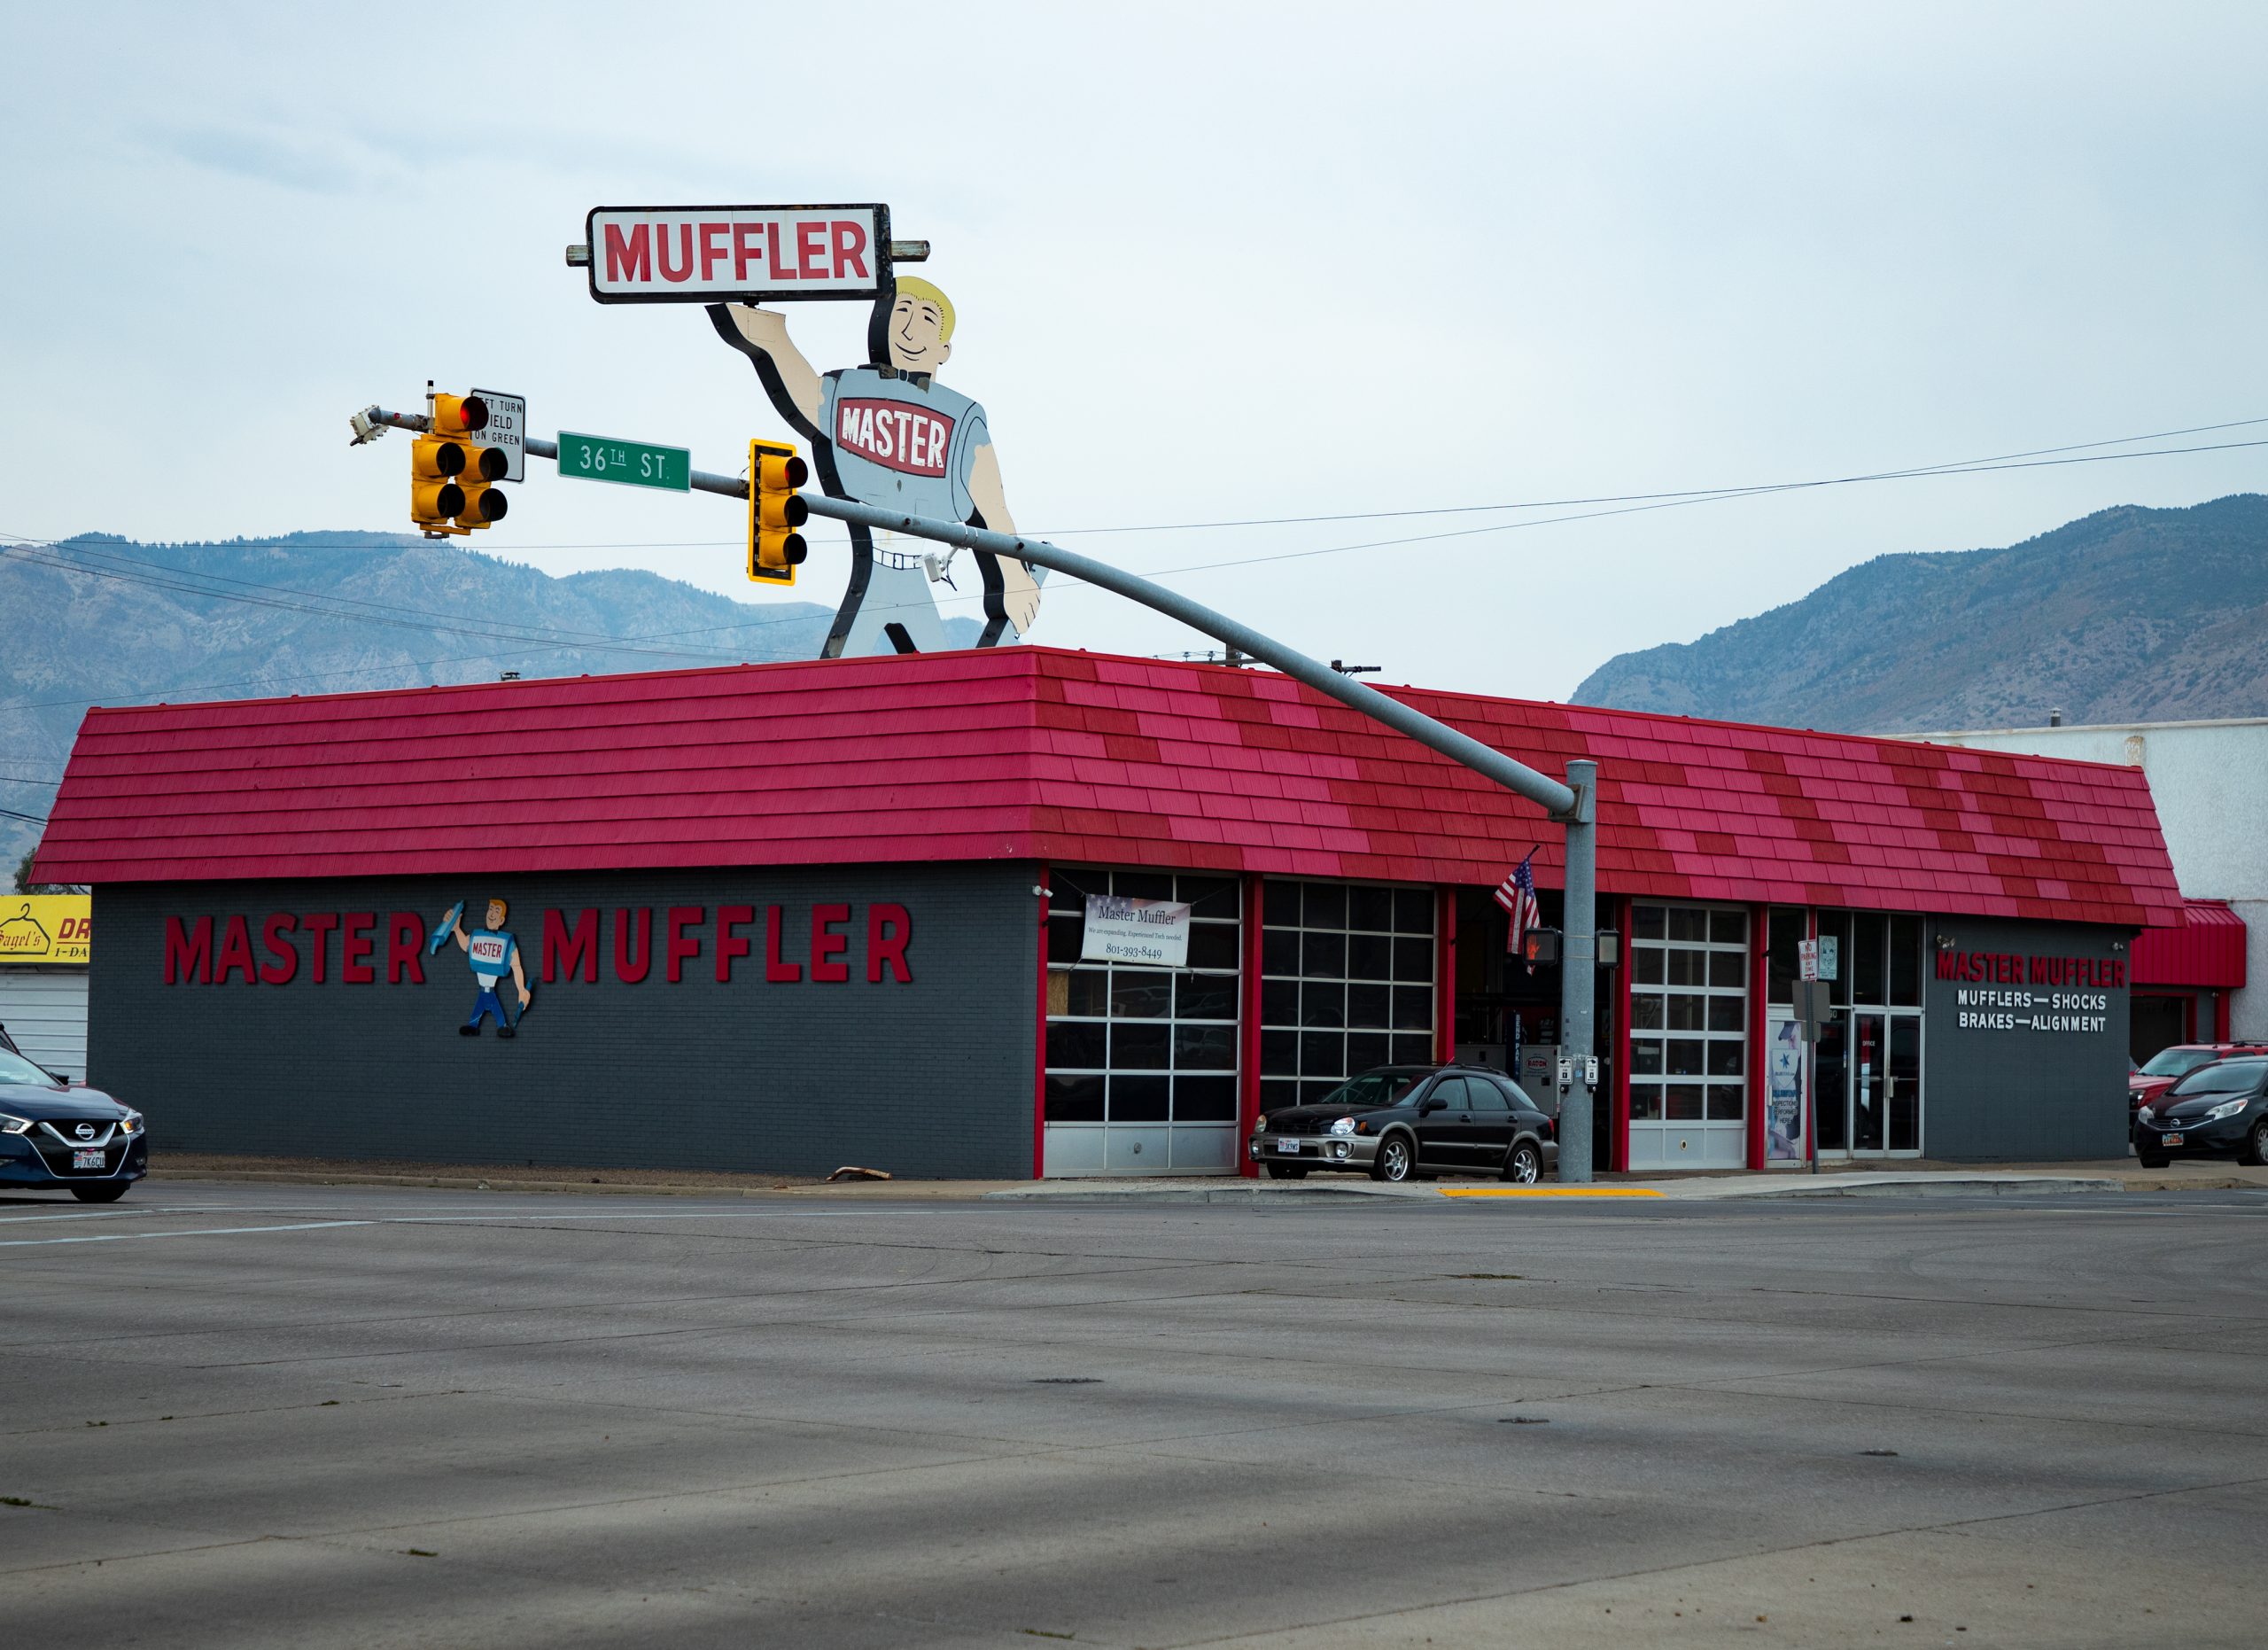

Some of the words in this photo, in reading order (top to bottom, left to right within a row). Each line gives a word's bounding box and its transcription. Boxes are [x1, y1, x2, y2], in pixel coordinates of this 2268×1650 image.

[604, 221, 869, 283] MUFFLER
[500, 401, 523, 414] TURN
[489, 414, 512, 430] IELD
[475, 430, 486, 440] ON
[492, 432, 520, 446] GREEN
[842, 407, 946, 468] MASTER
[579, 445, 626, 471] 36TH
[1099, 906, 1135, 922] Master
[1138, 909, 1177, 925] Muffler
[164, 911, 425, 985] MASTER
[472, 942, 502, 958] MASTER
[542, 902, 913, 984] MUFFLER
[1106, 943, 1162, 960] 801-393-8449
[1936, 950, 2025, 984] MASTER
[2030, 955, 2125, 988] MUFFLER
[2052, 992, 2106, 1010] SHOCKS
